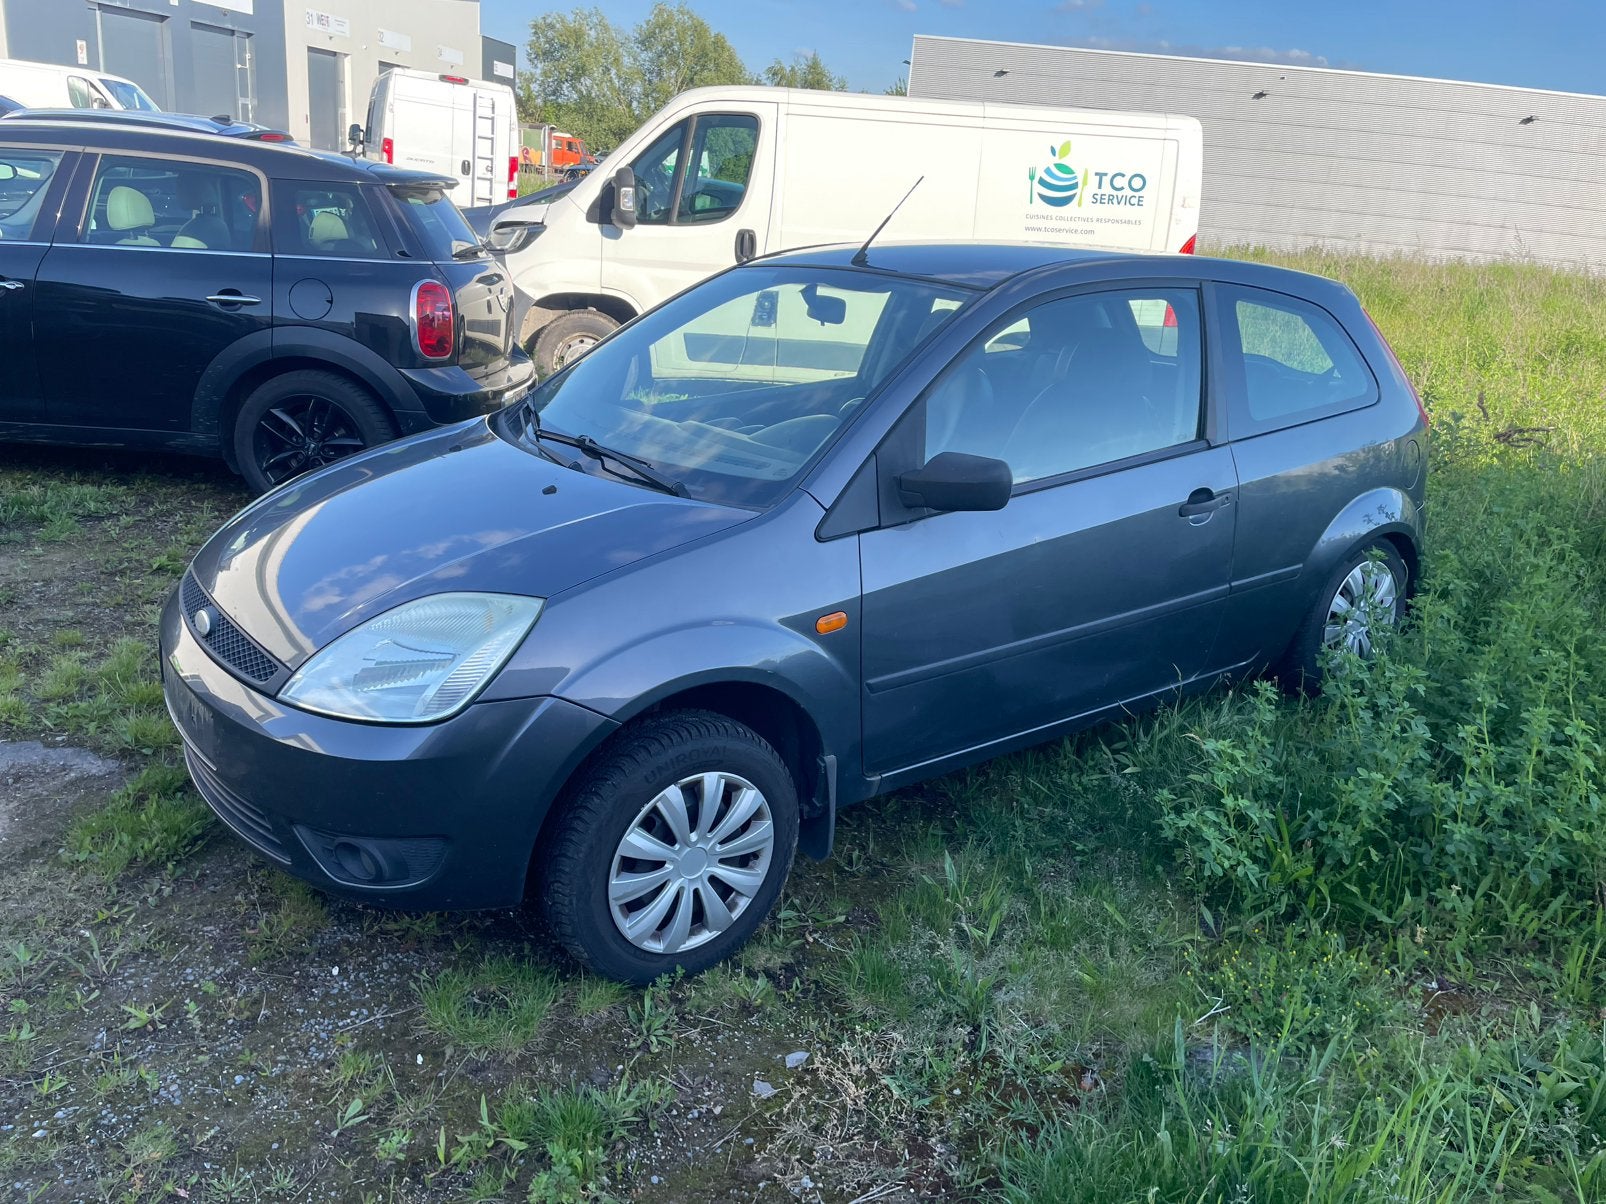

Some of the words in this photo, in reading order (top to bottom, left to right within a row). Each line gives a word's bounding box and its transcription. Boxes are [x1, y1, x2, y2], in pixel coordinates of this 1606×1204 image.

[1094, 171, 1147, 193] TCO
[1091, 193, 1145, 207] SERVICE
[1025, 213, 1053, 221] CUISINES
[1054, 215, 1094, 223] COLLECTIVES
[1095, 217, 1142, 226] RESPONSABLES
[1024, 226, 1095, 236] www.tcoservice.com
